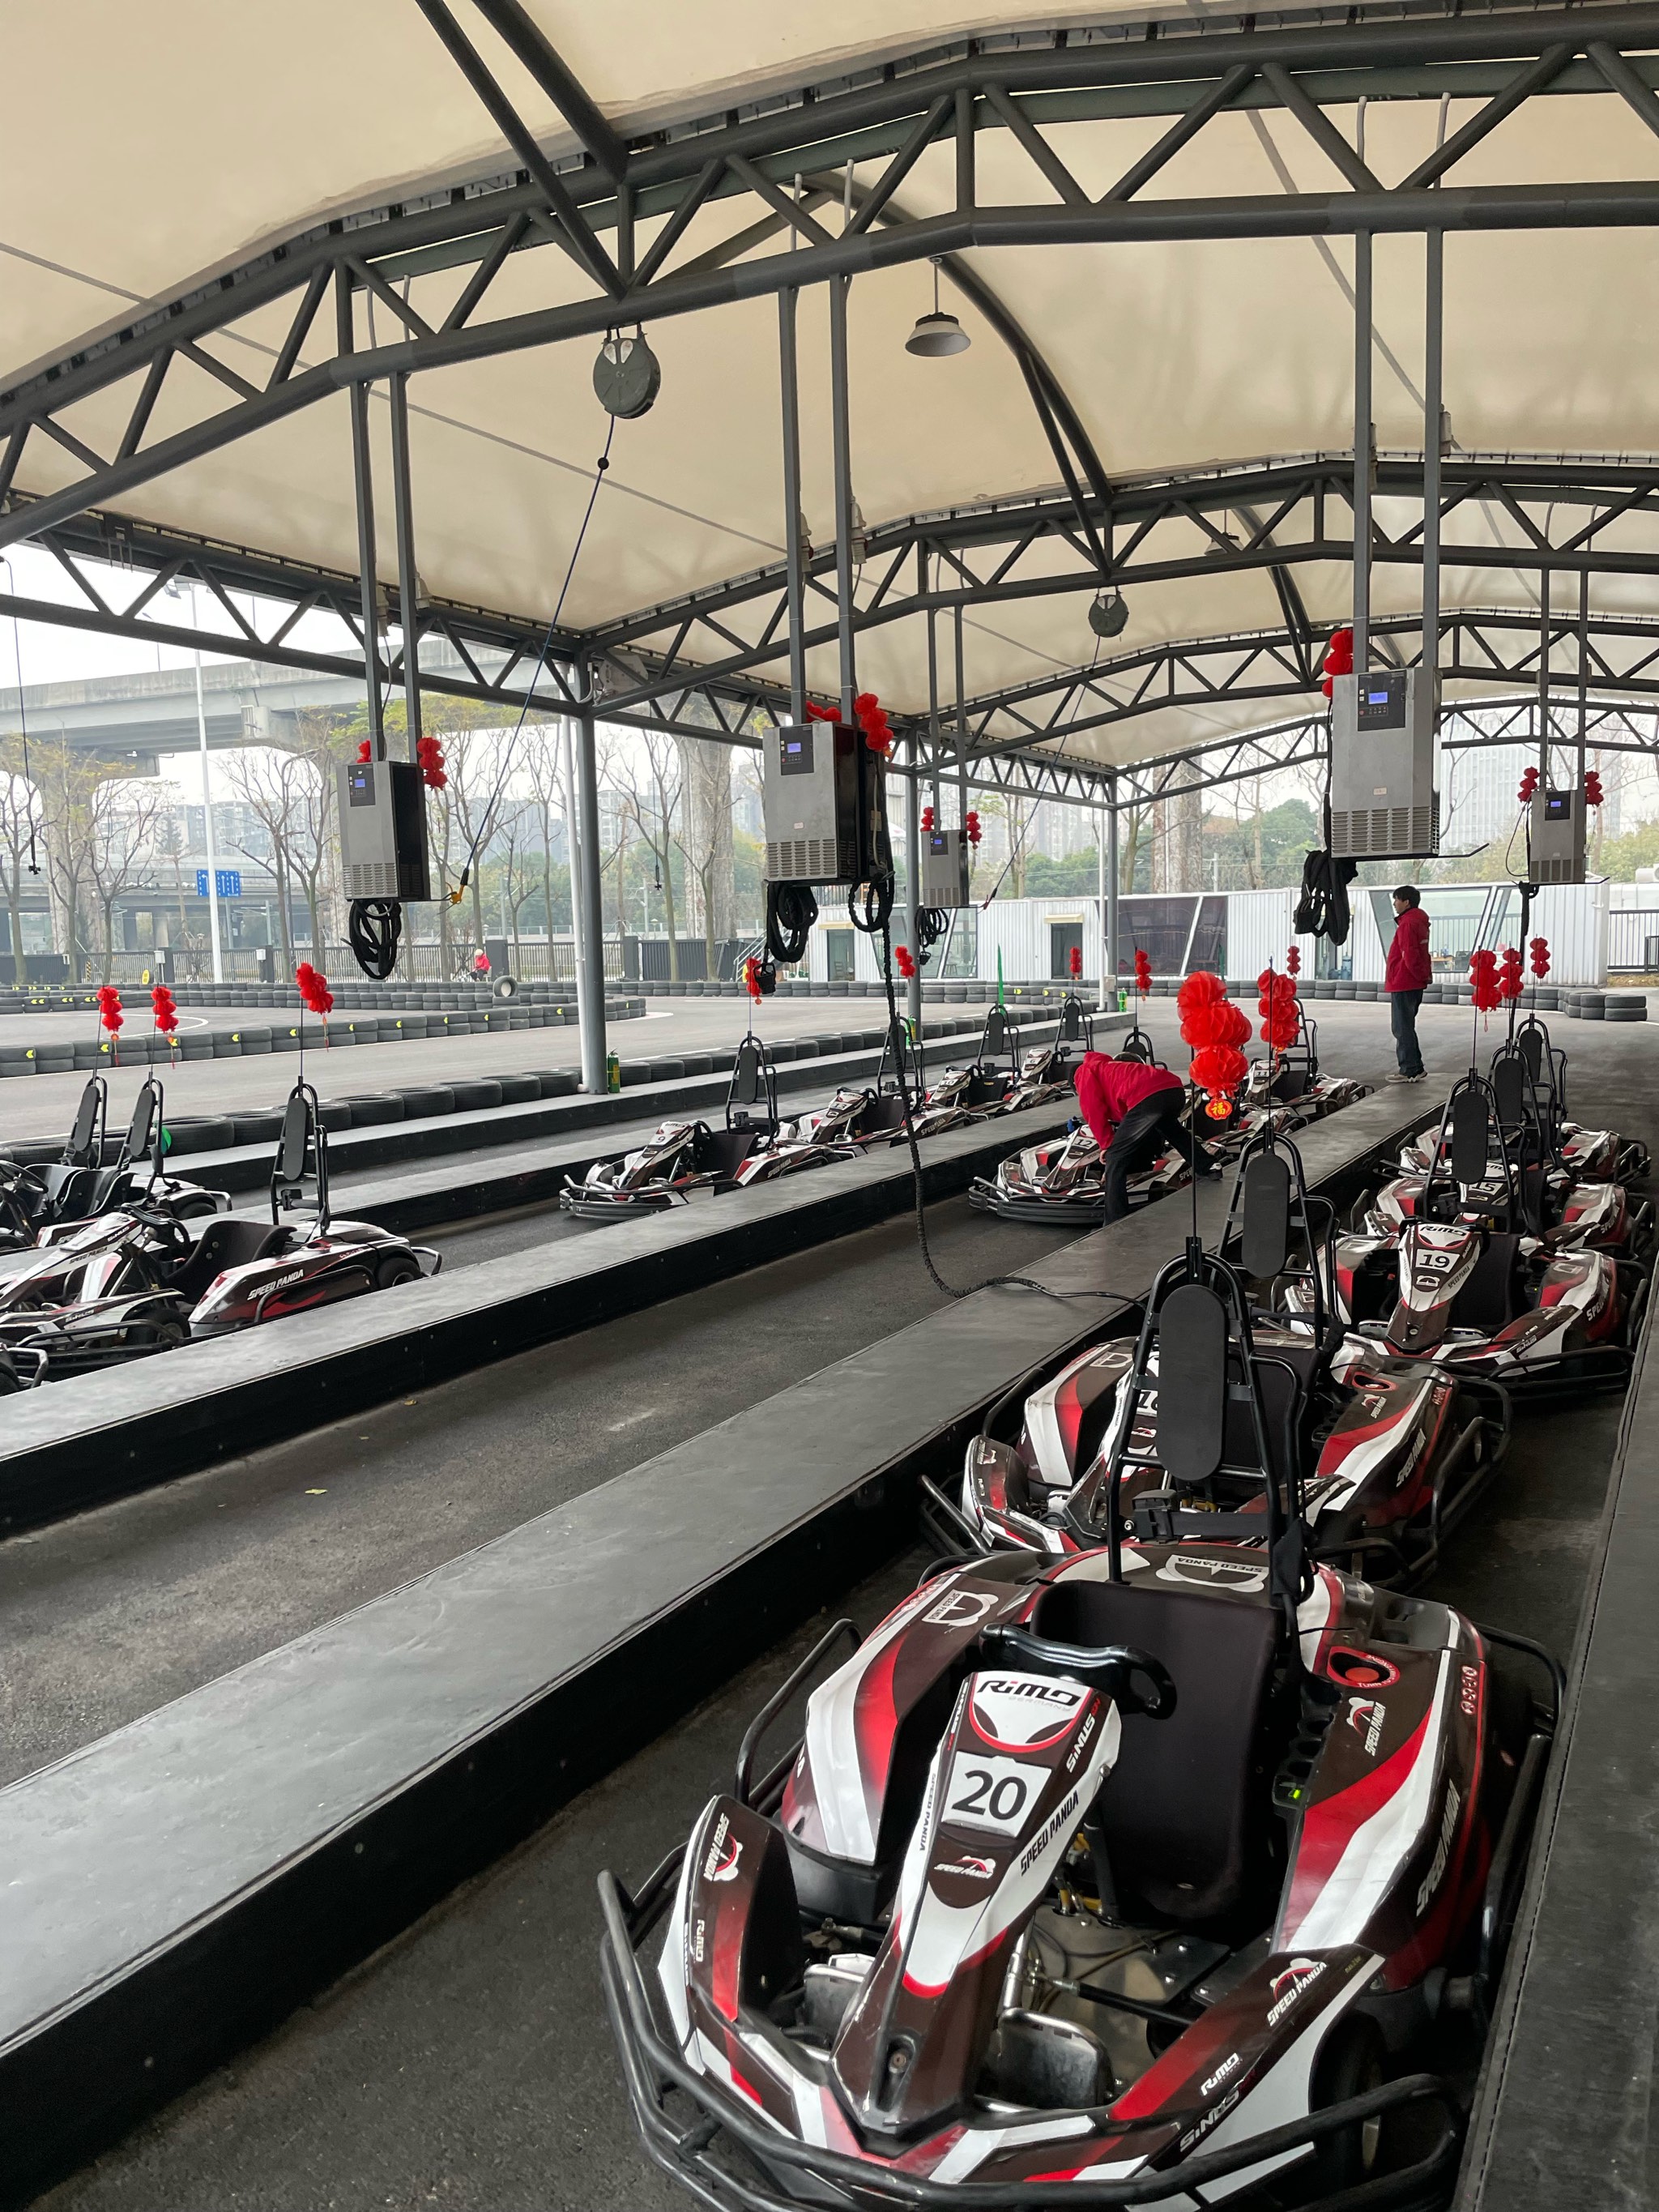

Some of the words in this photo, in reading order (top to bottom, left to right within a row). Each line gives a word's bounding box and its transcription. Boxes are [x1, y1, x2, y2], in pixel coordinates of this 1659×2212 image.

[1211, 1102, 1226, 1117] 福
[920, 1123, 935, 1136] SPEED
[1075, 1138, 1093, 1148] 12
[1419, 1254, 1450, 1268] 19
[247, 1280, 275, 1300] SPEED
[276, 1269, 304, 1287] PANDA
[1177, 1557, 1218, 1567] PANDA
[1221, 1563, 1263, 1573] SPEED
[928, 1604, 947, 1620] PANDA
[945, 1592, 961, 1607] SPEED
[977, 1680, 1081, 1707] RiMO
[1009, 1696, 1072, 1712] GERMANY
[1371, 1702, 1386, 1731] PANDA
[1066, 1713, 1096, 1773] SiNUS
[1364, 1725, 1380, 1757] SPEED
[927, 1772, 936, 1809] SPEED
[951, 1770, 1027, 1821] 20
[714, 1812, 730, 1848] SPEED
[919, 1810, 931, 1851] PANDA
[1021, 1830, 1049, 1877] SPEED
[1050, 1790, 1079, 1838] PANDA
[1417, 1836, 1446, 1917] SPEED
[1442, 1778, 1461, 1856] PANDA
[703, 1843, 721, 1882] PANDA
[934, 1862, 960, 1874] SPEED
[962, 1866, 992, 1880] PANDA
[1267, 1986, 1298, 2026] SPEED
[1296, 1961, 1328, 1993] PANDA
